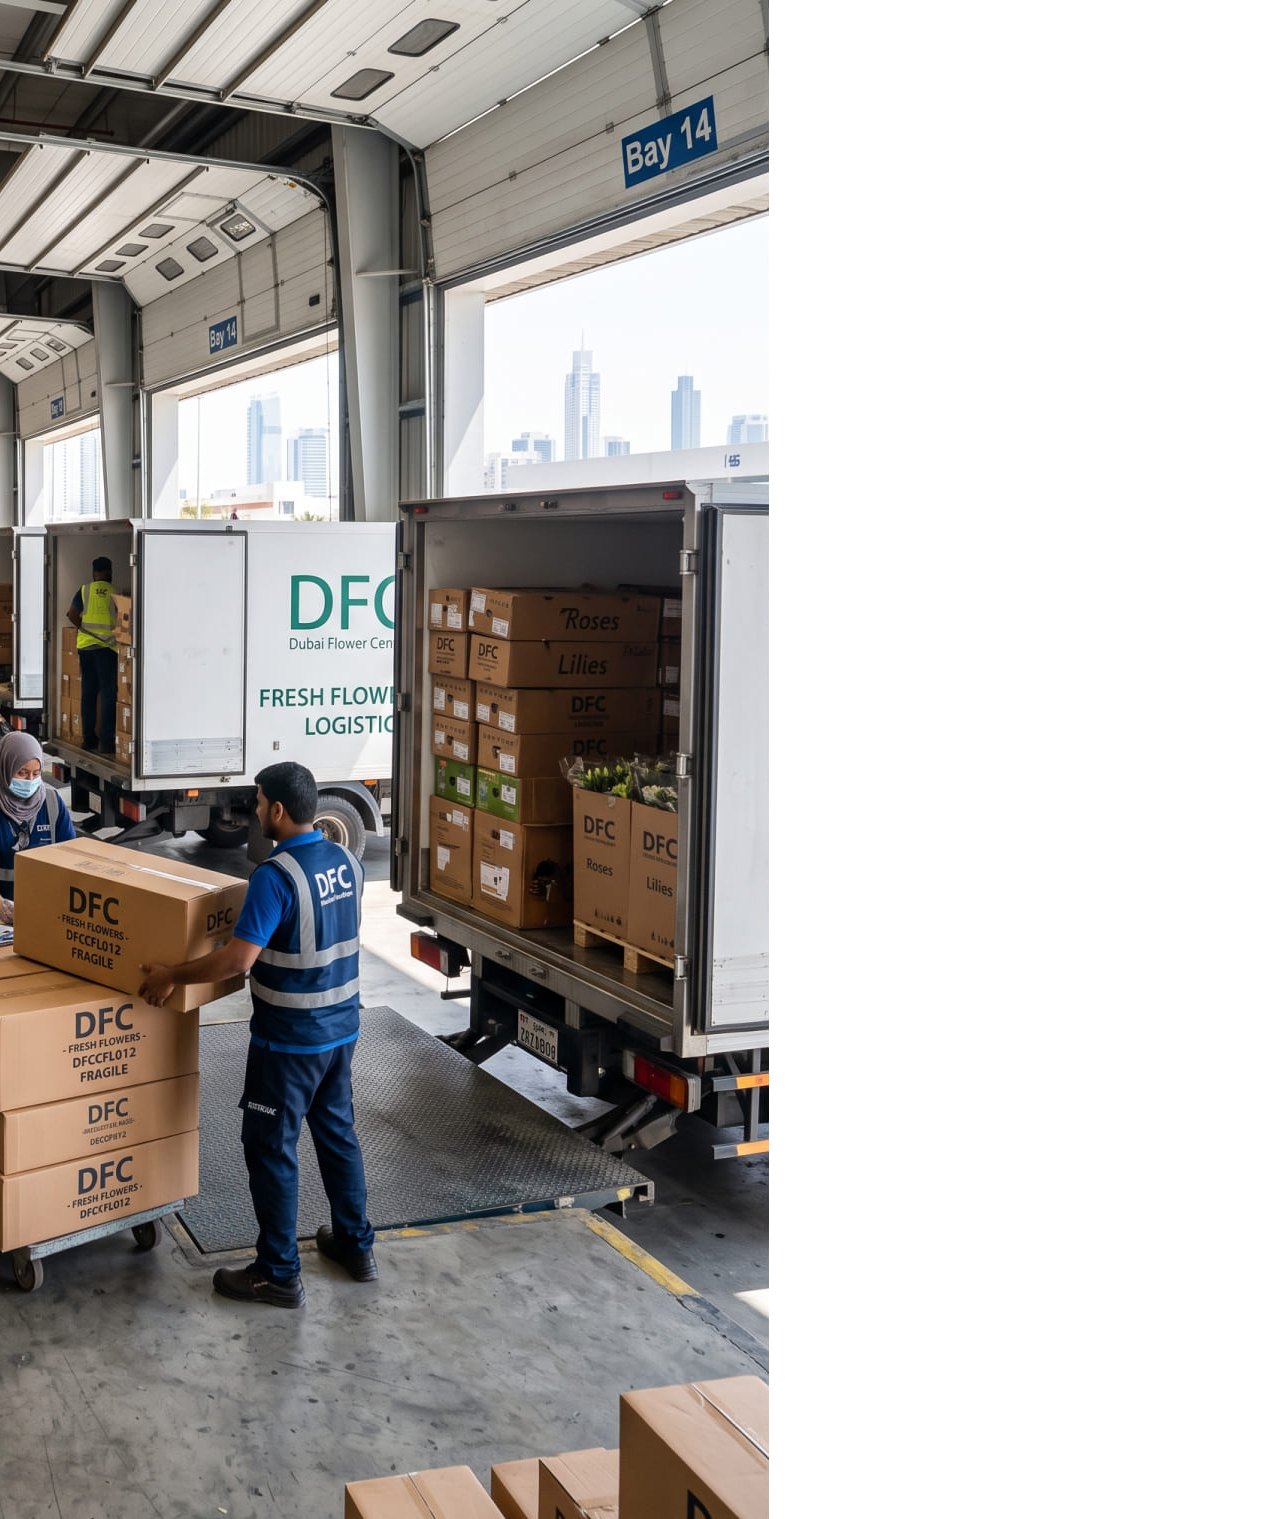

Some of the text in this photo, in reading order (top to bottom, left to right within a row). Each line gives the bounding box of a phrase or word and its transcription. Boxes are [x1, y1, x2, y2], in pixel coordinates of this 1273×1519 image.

[626, 107, 712, 175] Bay 14
[227, 321, 236, 341] 14
[559, 607, 620, 630] Roses
[289, 637, 395, 650] Dubai Flower Cen
[437, 637, 454, 651] DFC
[478, 643, 498, 659] DFC
[558, 654, 608, 675] Lilies
[260, 688, 324, 707] FRESH
[572, 696, 606, 712] DFC
[573, 739, 607, 756] DFC
[584, 814, 615, 840] DFC
[643, 831, 678, 859] DFC
[587, 857, 613, 876] Roses
[314, 864, 352, 898] DFC
[647, 876, 673, 897] Lilies
[69, 886, 119, 925] DFC
[62, 914, 85, 929] FRESH
[87, 921, 124, 940] FLOWERS
[206, 907, 233, 931] DFC
[66, 929, 121, 955] DFCCFL012
[71, 947, 114, 970] FRAGILE
[75, 1003, 134, 1039] DFC
[68, 1041, 96, 1053] FRESH
[99, 1032, 140, 1048] FLOWERS
[72, 1047, 136, 1068] DFCCFL012
[80, 1063, 128, 1082] FRAGILE
[88, 1098, 128, 1124] DFC
[78, 1156, 134, 1195] DFC
[72, 1194, 98, 1209] FRESH
[100, 1183, 138, 1201] FLOWERS
